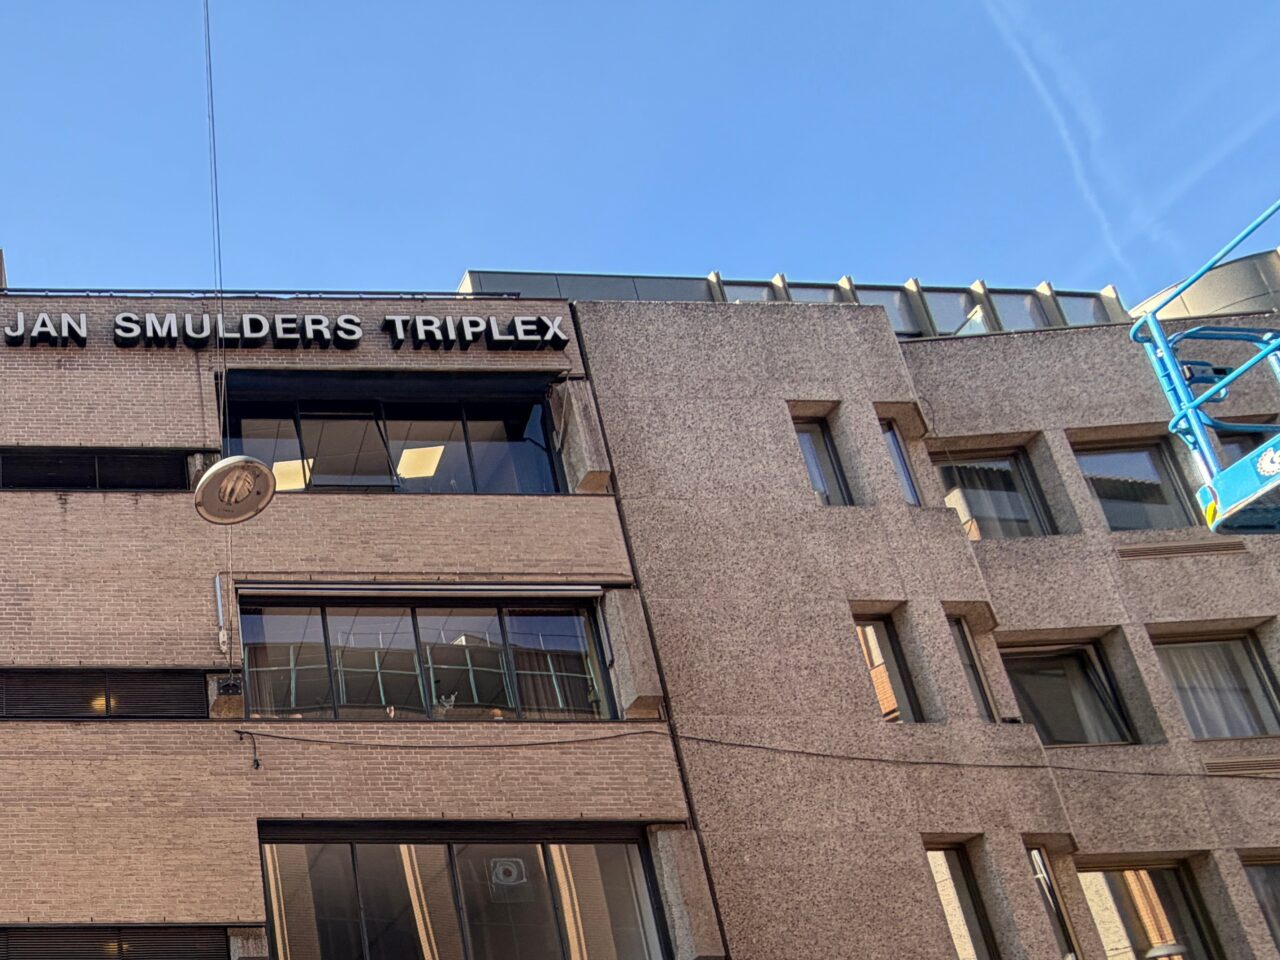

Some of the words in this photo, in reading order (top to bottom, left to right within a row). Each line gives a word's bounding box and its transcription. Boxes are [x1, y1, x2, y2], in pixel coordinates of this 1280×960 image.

[4, 312, 87, 338] JAN
[114, 312, 363, 340] SMULDERS
[385, 316, 569, 340] TRIPLEX
